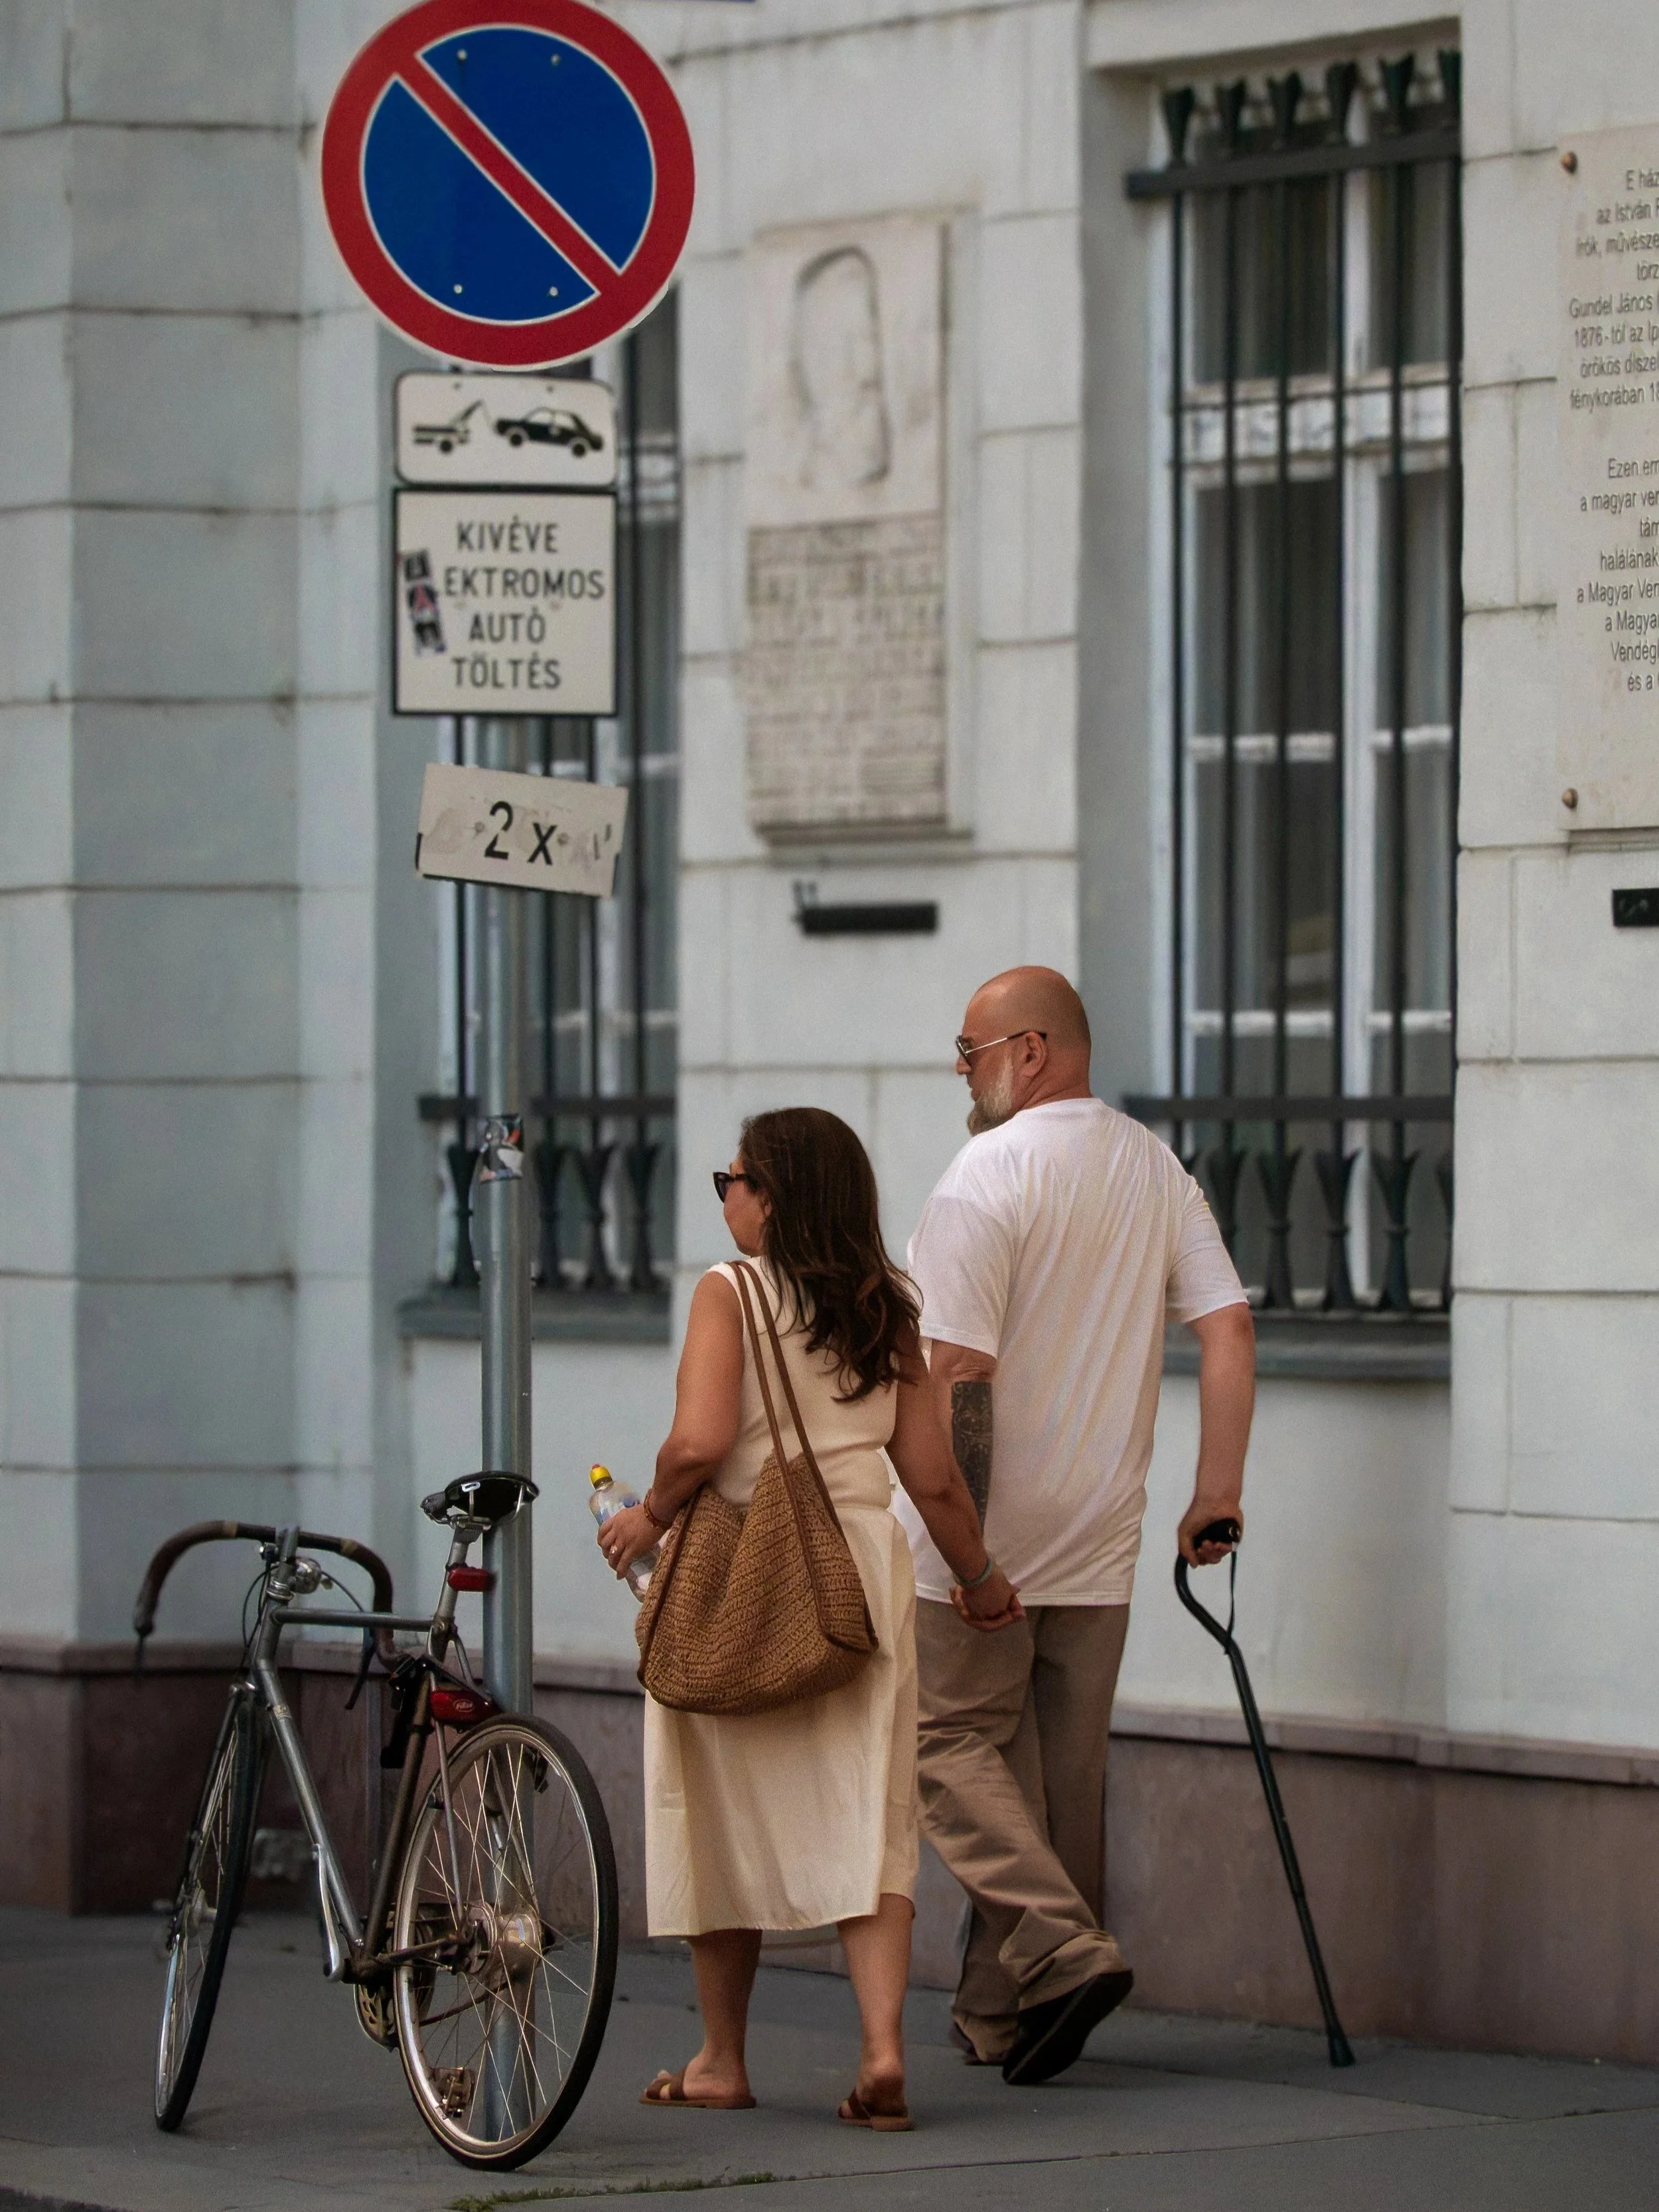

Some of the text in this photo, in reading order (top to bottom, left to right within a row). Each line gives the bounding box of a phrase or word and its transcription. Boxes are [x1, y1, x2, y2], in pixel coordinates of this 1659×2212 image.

[1626, 169, 1634, 191] E
[1597, 208, 1611, 224] az
[1615, 201, 1652, 222] István
[1569, 294, 1613, 319] Gundel
[1617, 293, 1653, 313] János
[1630, 326, 1643, 342] az
[1581, 355, 1621, 379] örökös
[1570, 383, 1645, 413] fénykorában
[1608, 458, 1639, 479] Ezen
[1580, 496, 1588, 512] a
[1591, 492, 1638, 514] magyar
[457, 514, 558, 553] KIVÉVE
[1640, 515, 1659, 538] tám
[1600, 545, 1659, 571] halálának
[445, 565, 605, 600] EKTROMOS
[1577, 577, 1659, 607] a Magyar Ven
[468, 604, 546, 644] AUTÓ
[1605, 610, 1659, 636] a Magya
[451, 651, 562, 690] TÖLTÉS
[1627, 671, 1642, 692] és
[1645, 674, 1653, 691] a
[484, 800, 514, 861] 2
